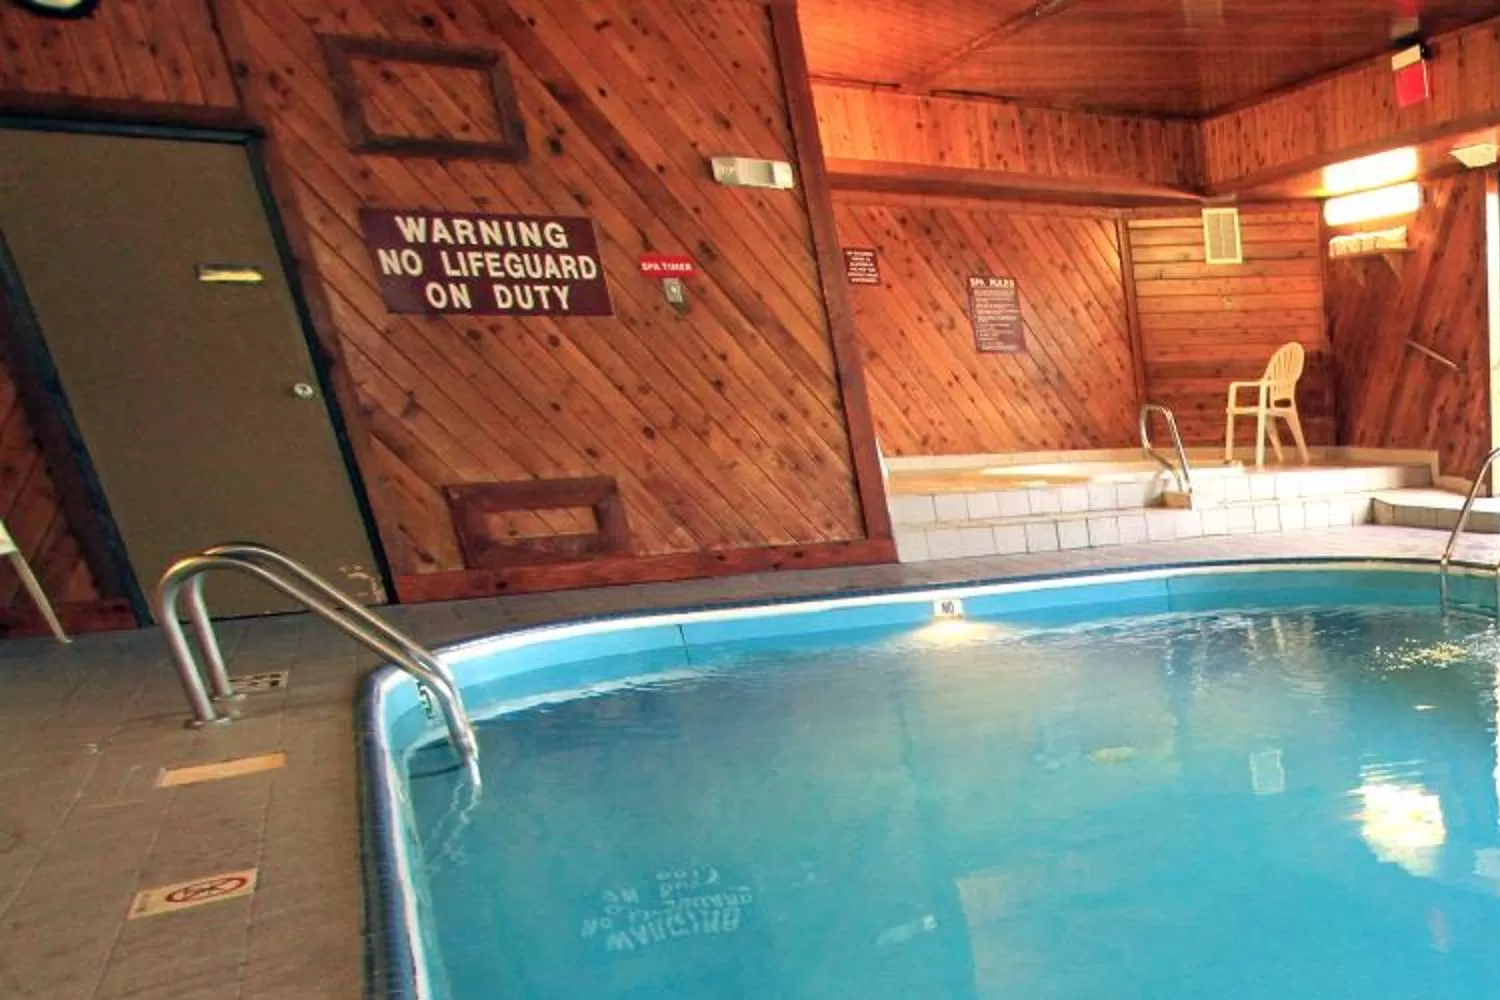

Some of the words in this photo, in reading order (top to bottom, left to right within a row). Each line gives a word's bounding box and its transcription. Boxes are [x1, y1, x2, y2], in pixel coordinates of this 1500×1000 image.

[394, 215, 568, 249] WARNING
[377, 248, 423, 277] NO
[440, 250, 597, 279] LIFEGUARD
[425, 281, 472, 309] ON
[492, 283, 569, 310] DUTY
[969, 276, 986, 288] SPA
[989, 278, 1015, 289] RULES
